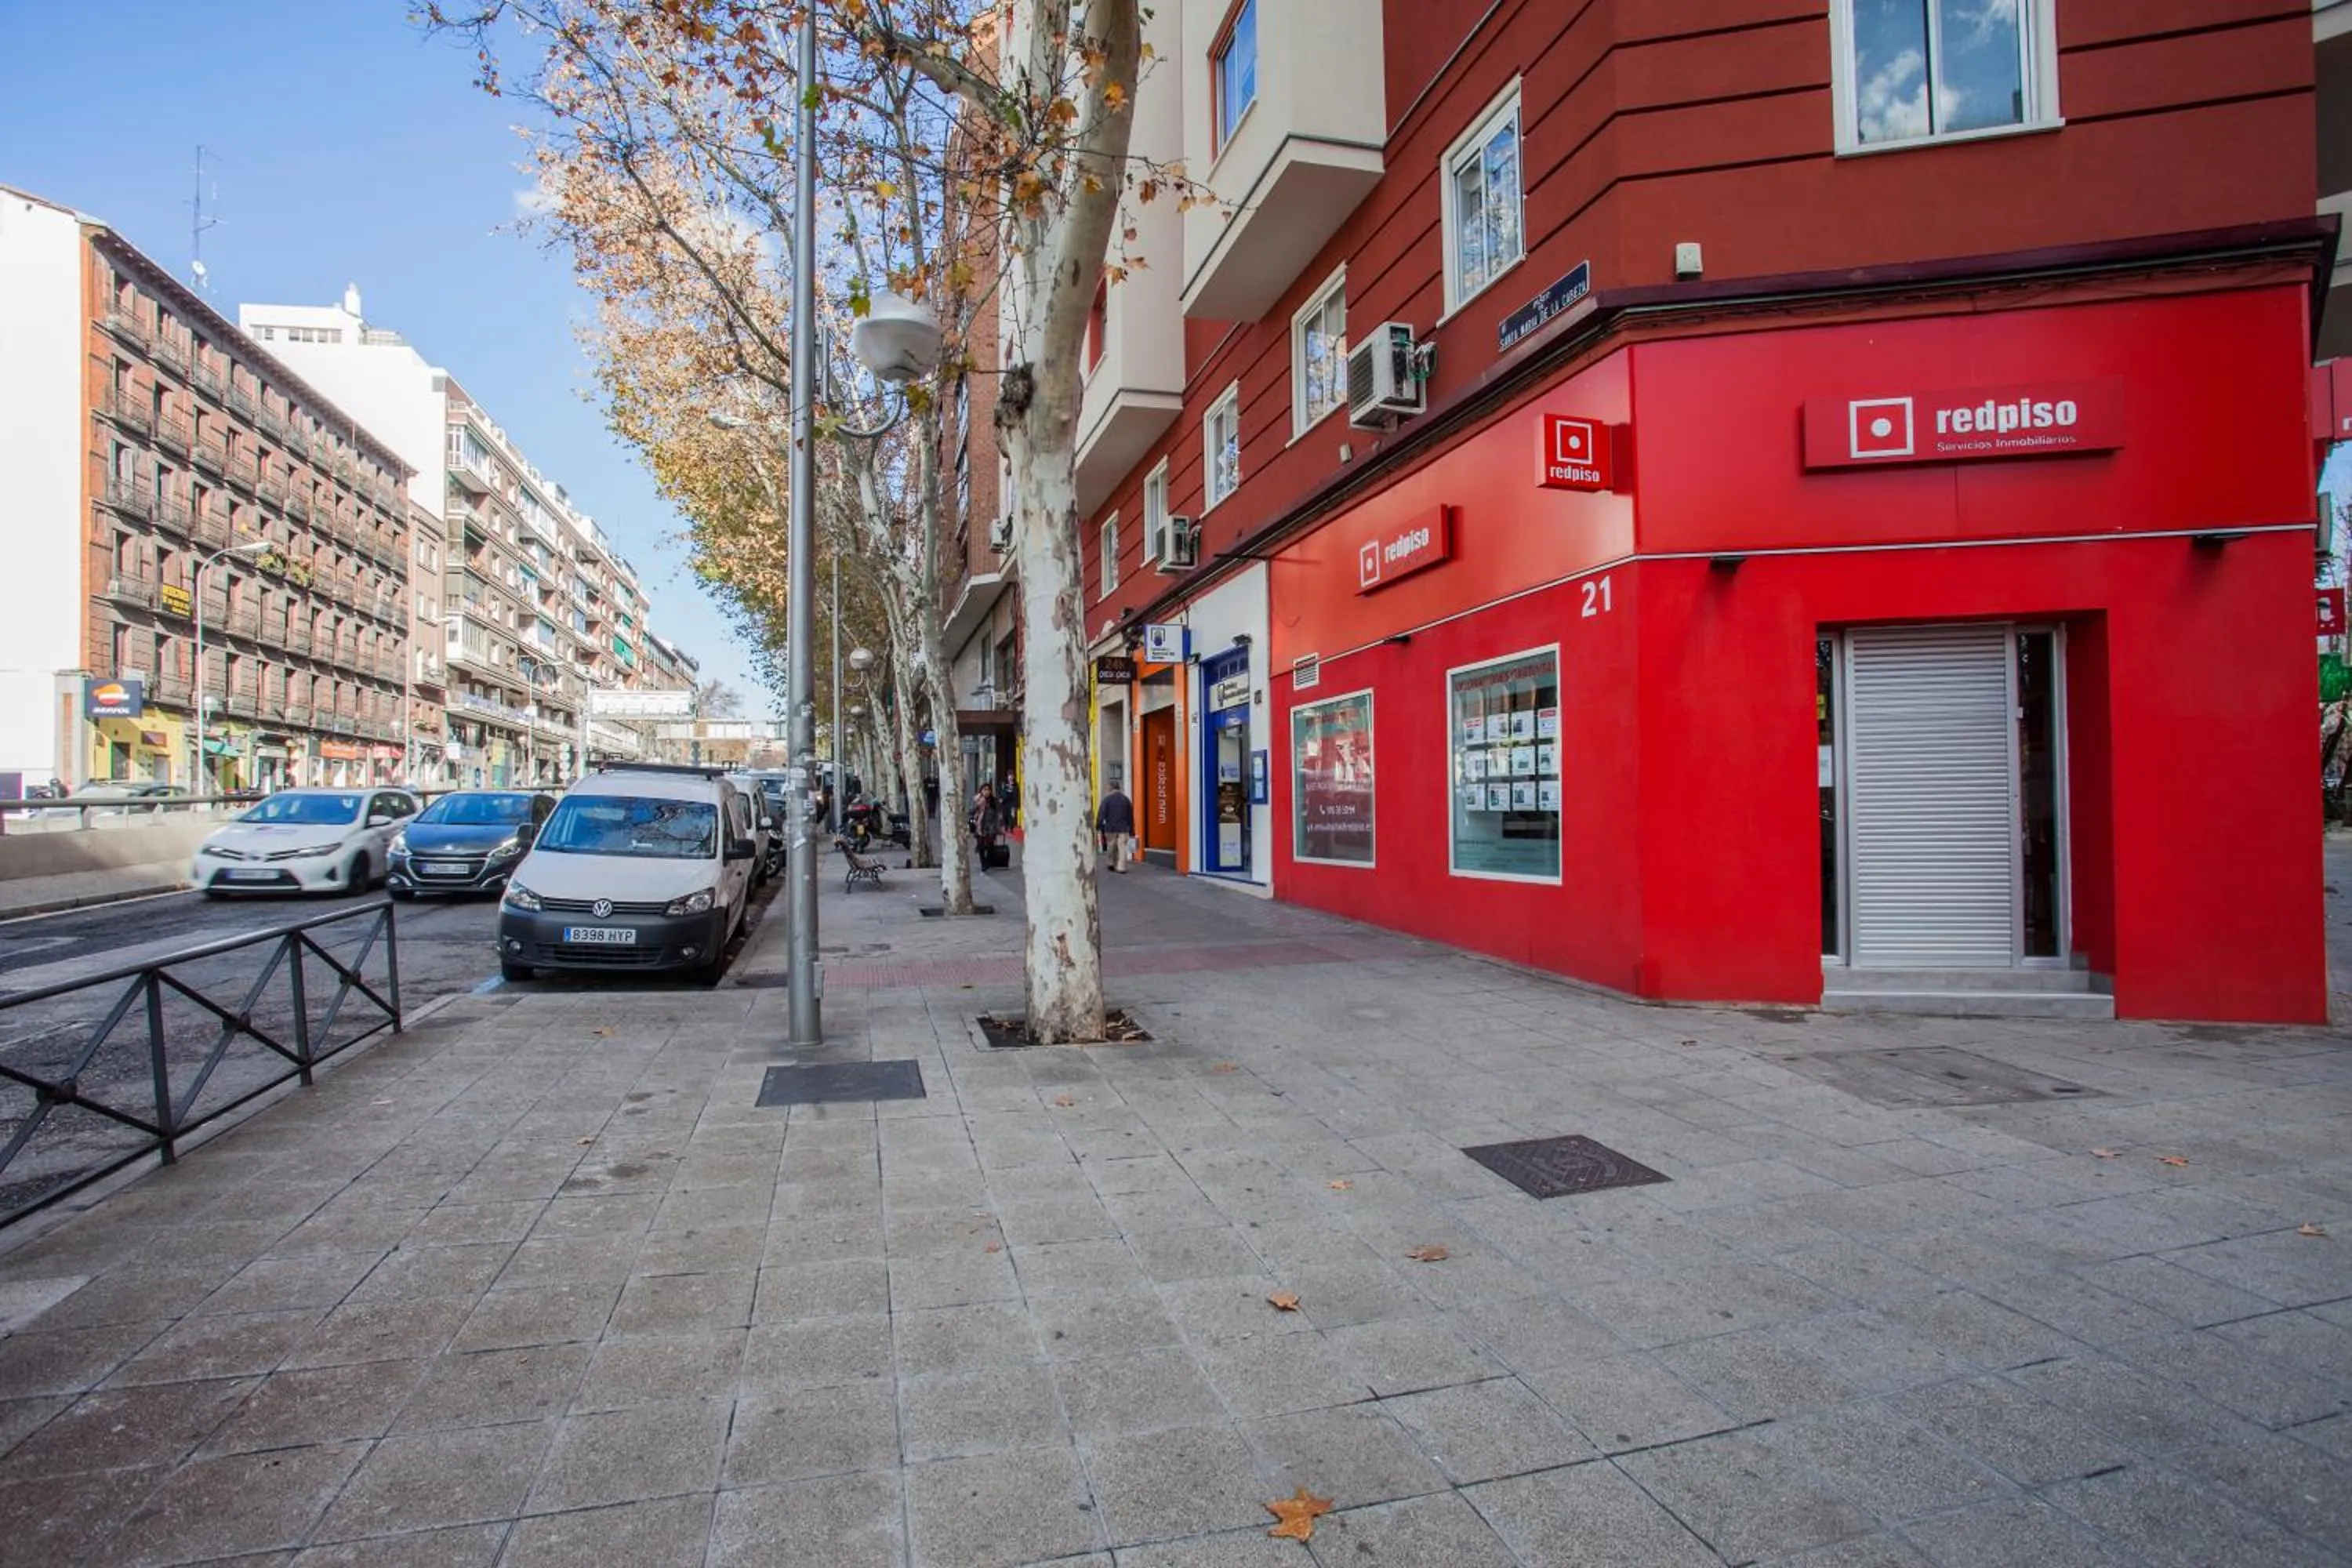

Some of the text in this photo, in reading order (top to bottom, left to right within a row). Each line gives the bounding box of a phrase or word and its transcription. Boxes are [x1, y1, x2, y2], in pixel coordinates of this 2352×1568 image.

[1936, 397, 2077, 433] redpiso
[1937, 436, 2077, 452] Servicios Inmobiliarios
[1550, 465, 1600, 482] redpiso
[1385, 527, 1429, 564] redpiso
[1581, 575, 1611, 618] 21
[573, 929, 633, 942] 8398 HYP
